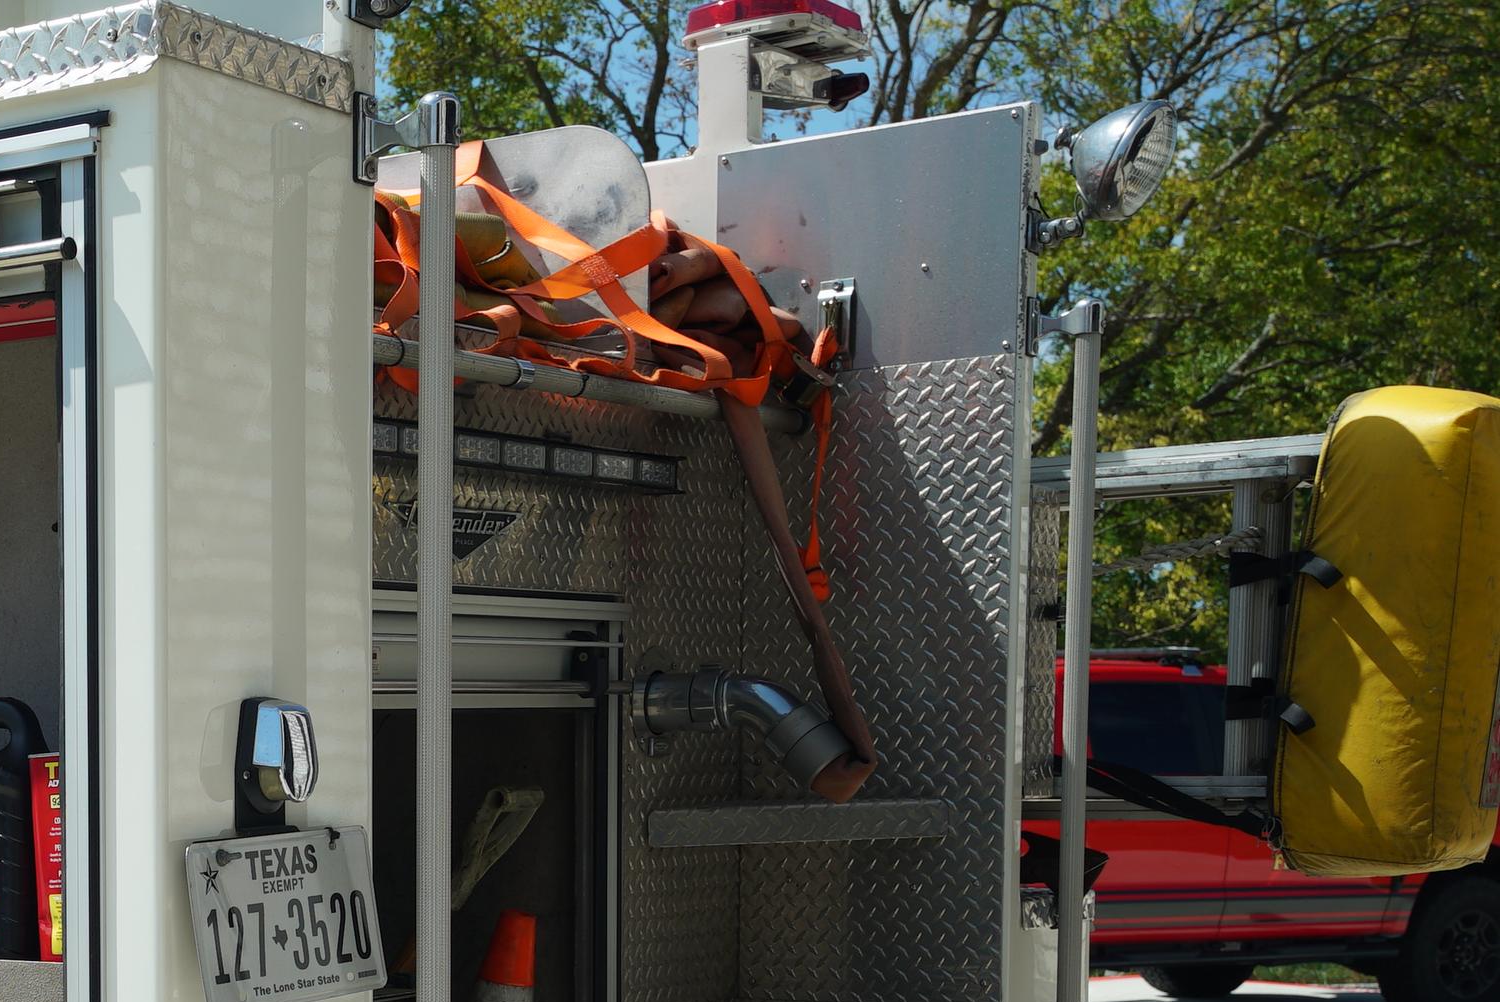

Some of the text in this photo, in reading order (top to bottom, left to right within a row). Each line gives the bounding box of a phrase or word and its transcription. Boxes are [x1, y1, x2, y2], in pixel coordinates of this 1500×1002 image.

[245, 844, 318, 881] TEXAS
[262, 877, 305, 894] EXEMPT
[206, 890, 372, 985] 127 3520
[253, 973, 340, 997] The Lone Star State
